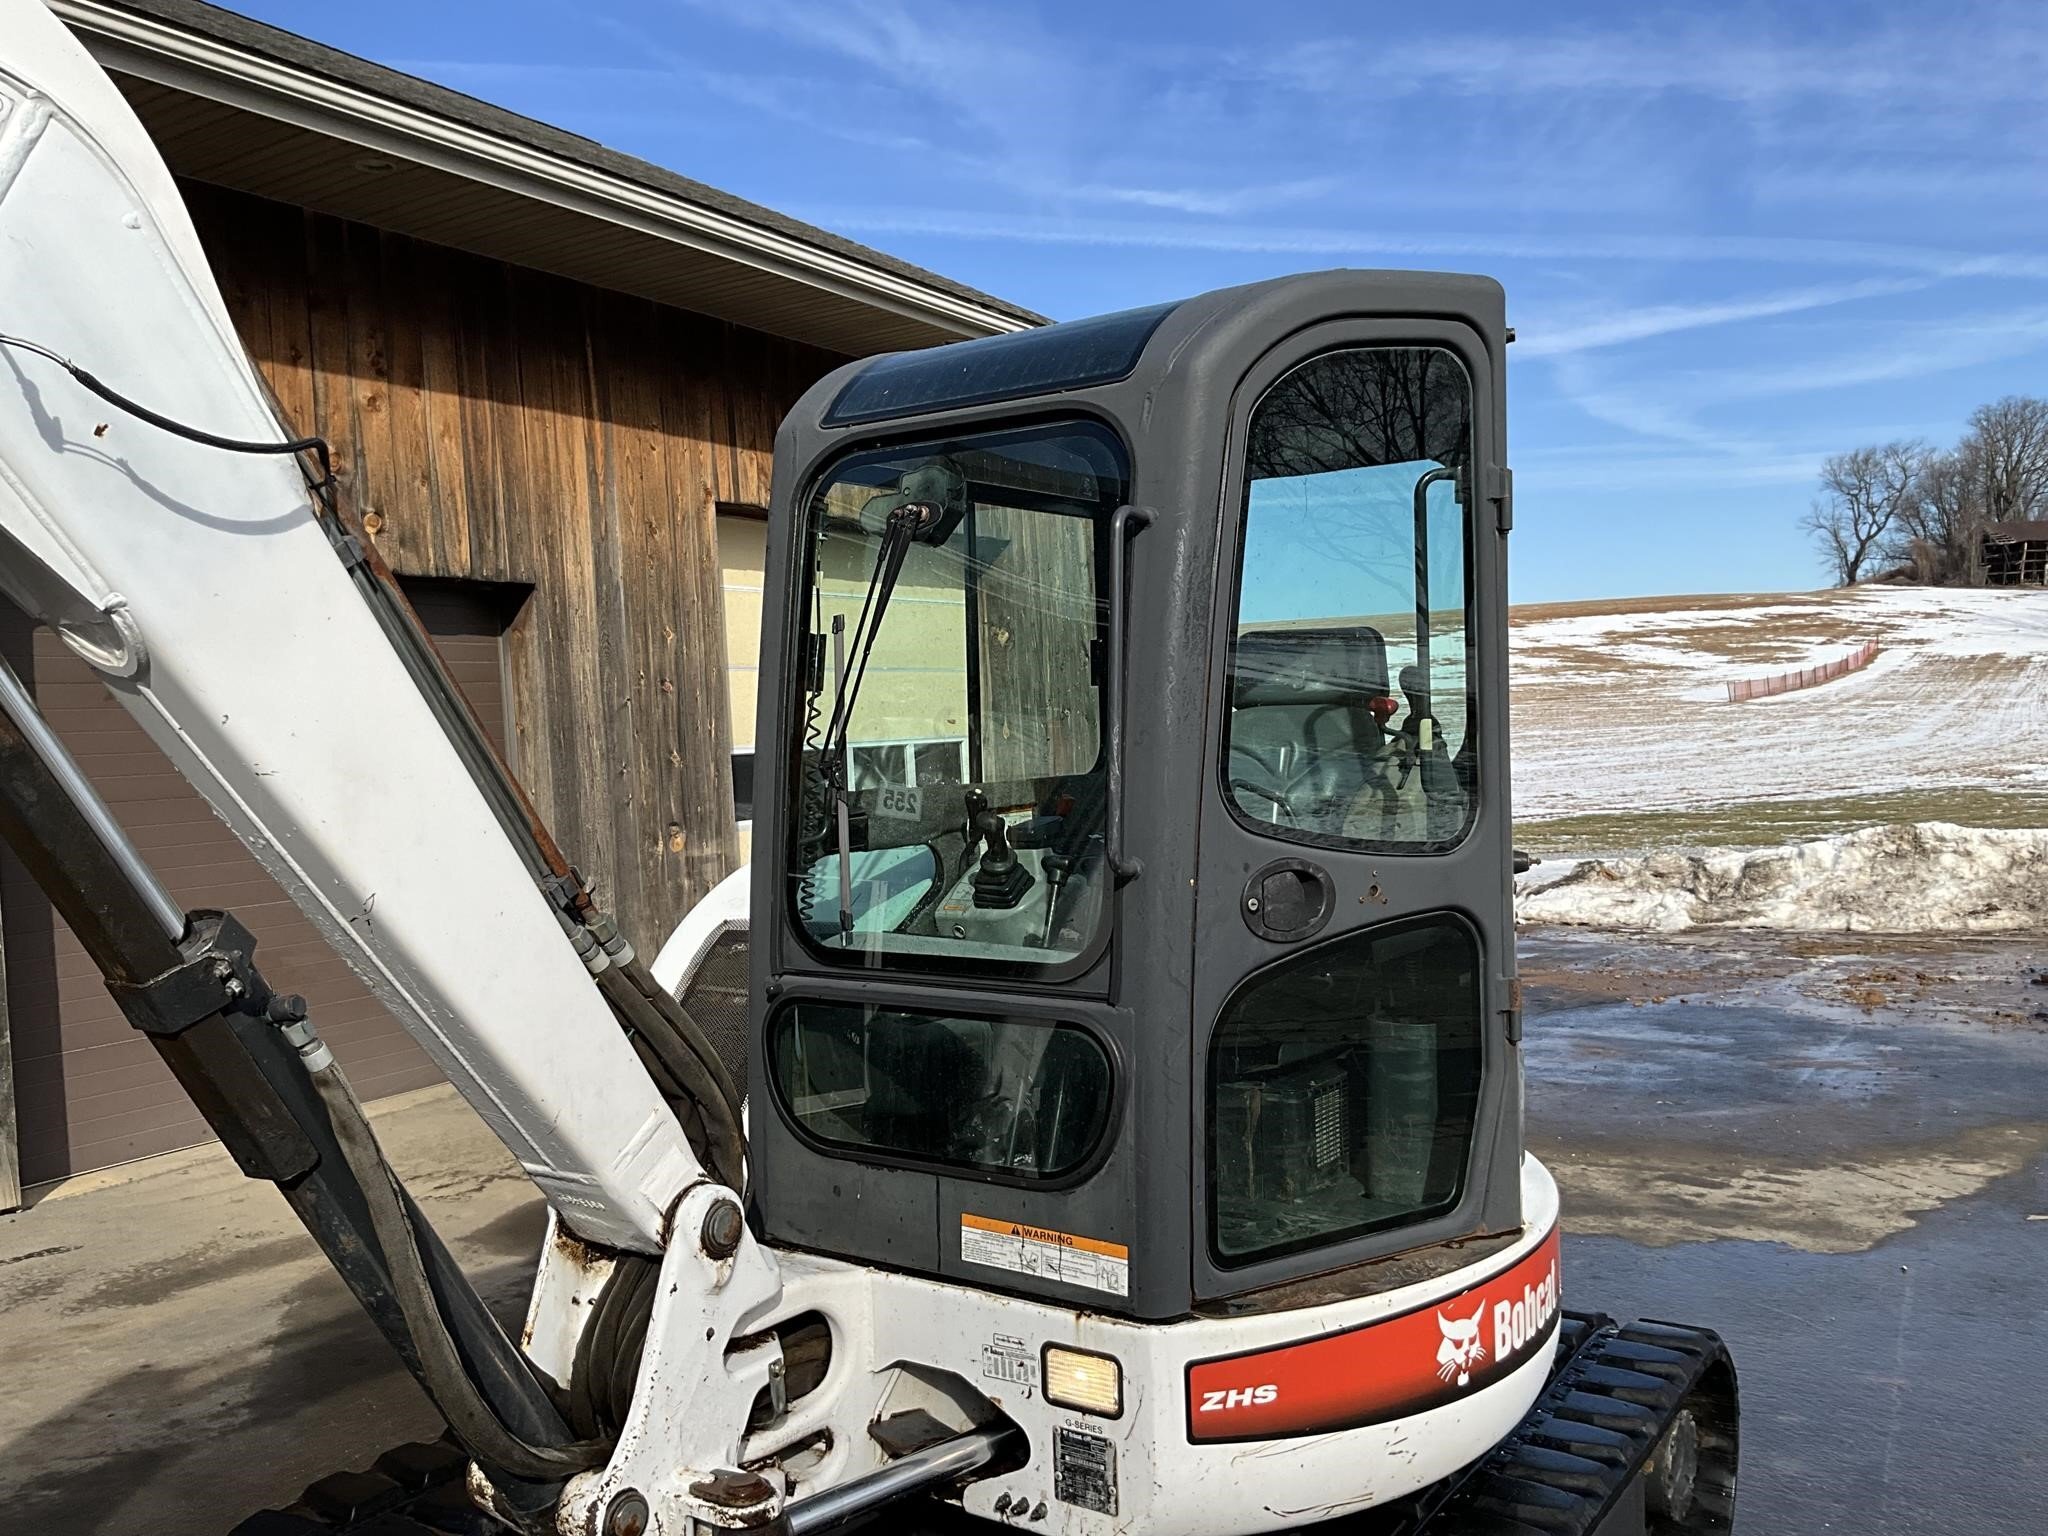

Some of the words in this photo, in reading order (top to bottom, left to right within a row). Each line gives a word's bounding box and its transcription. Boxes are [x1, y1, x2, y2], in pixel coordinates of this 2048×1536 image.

[1024, 1227, 1074, 1246] WARNING
[1494, 1258, 1558, 1362] Bobcat
[1200, 1384, 1278, 1411] ZHS
[1065, 1418, 1103, 1434] G-SERIES
